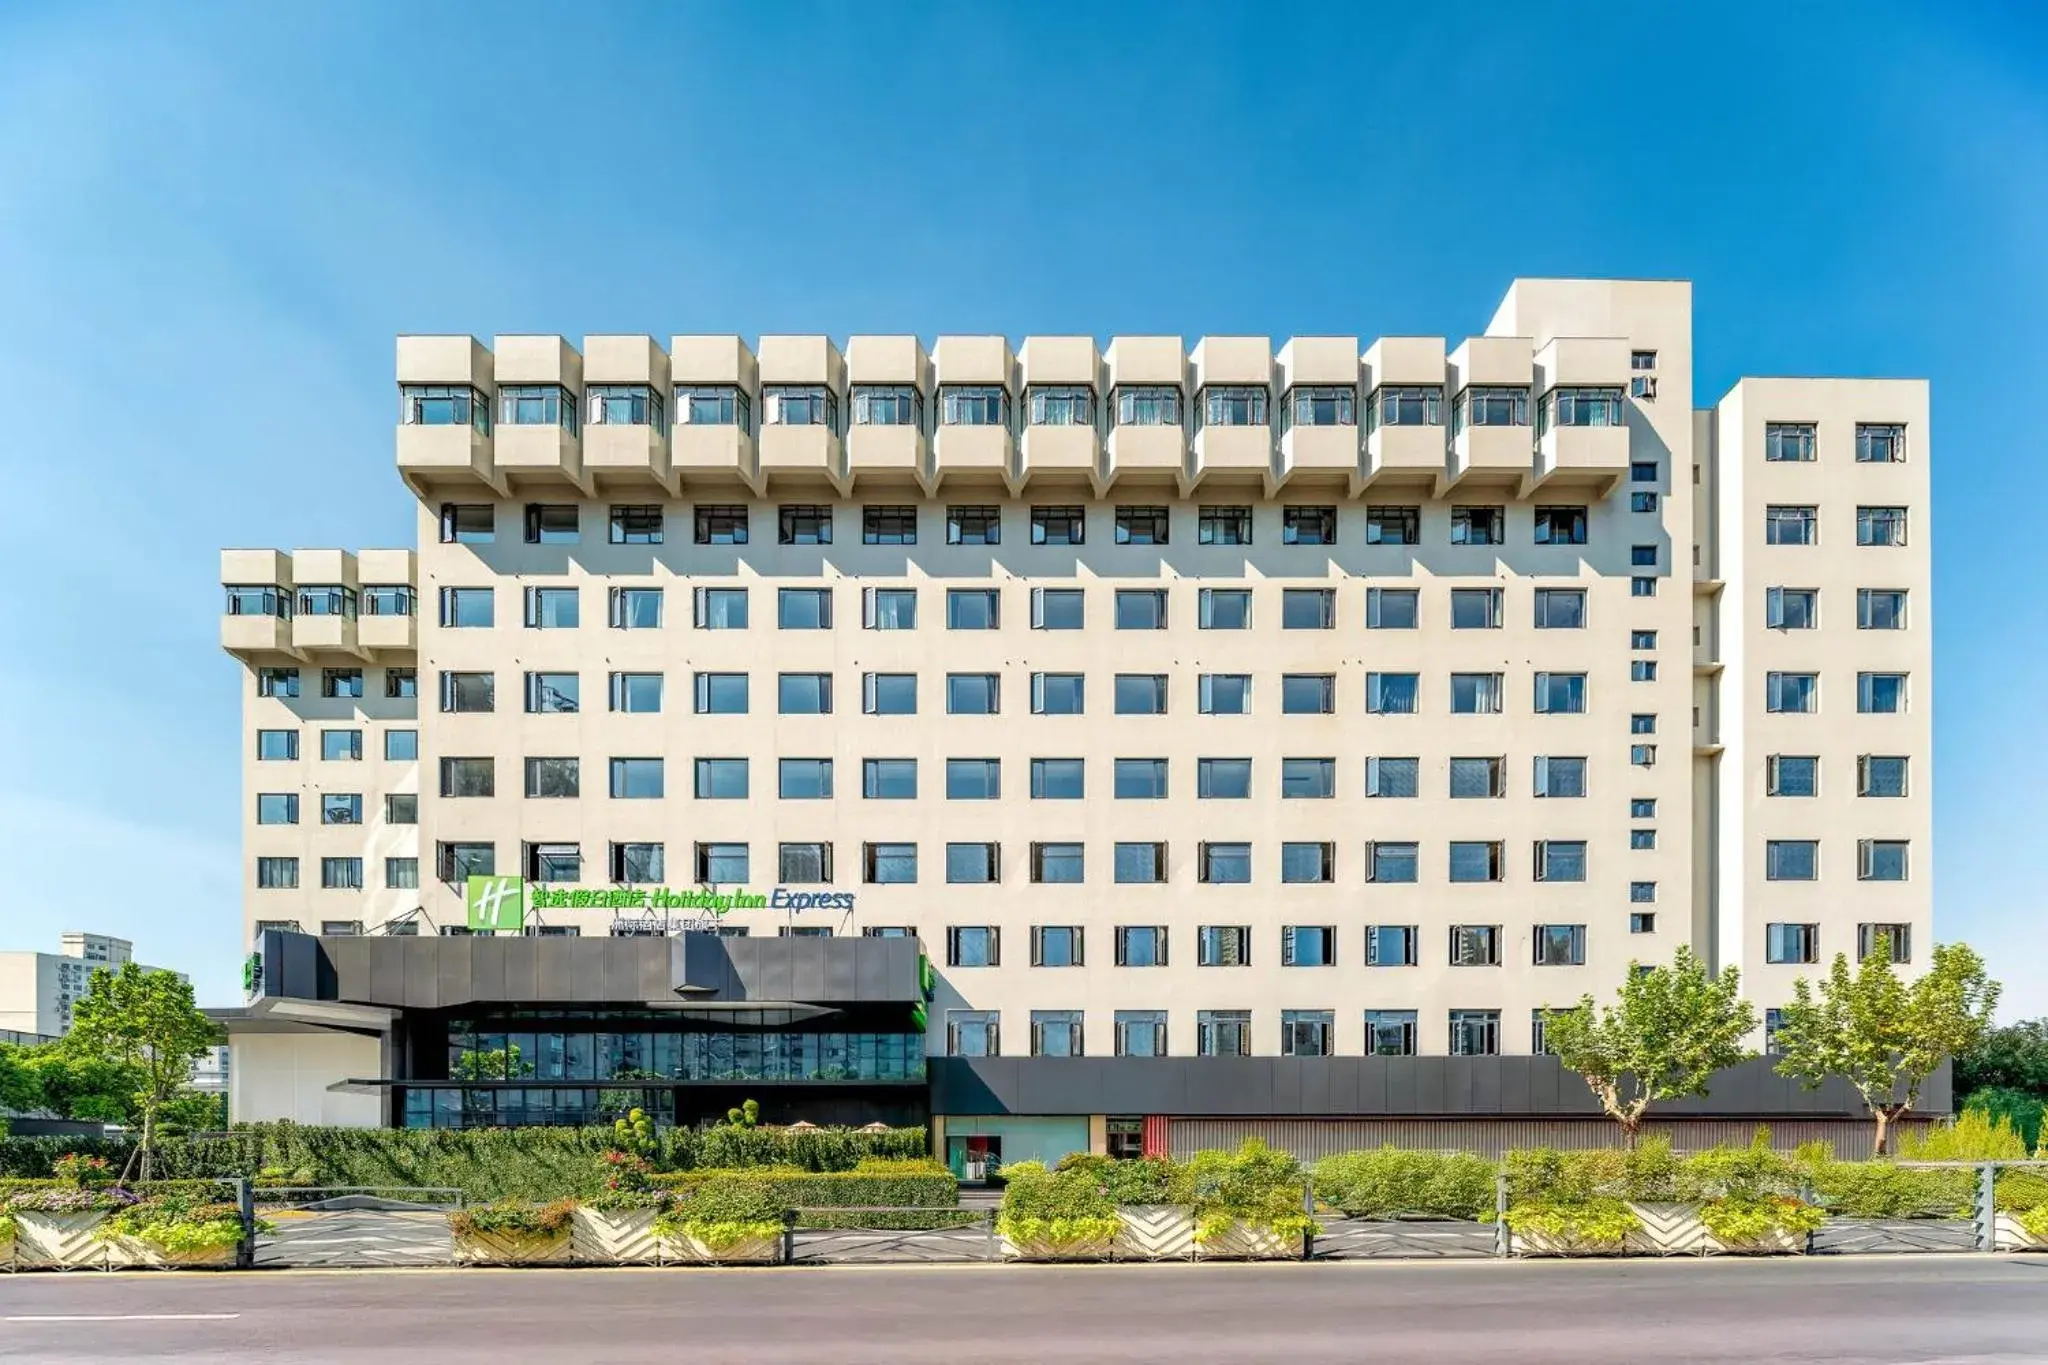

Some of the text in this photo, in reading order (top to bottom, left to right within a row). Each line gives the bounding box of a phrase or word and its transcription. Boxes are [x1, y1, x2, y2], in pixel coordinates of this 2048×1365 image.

[531, 888, 647, 908] 智选假日酒店
[652, 887, 855, 914] Holiday Inn Express
